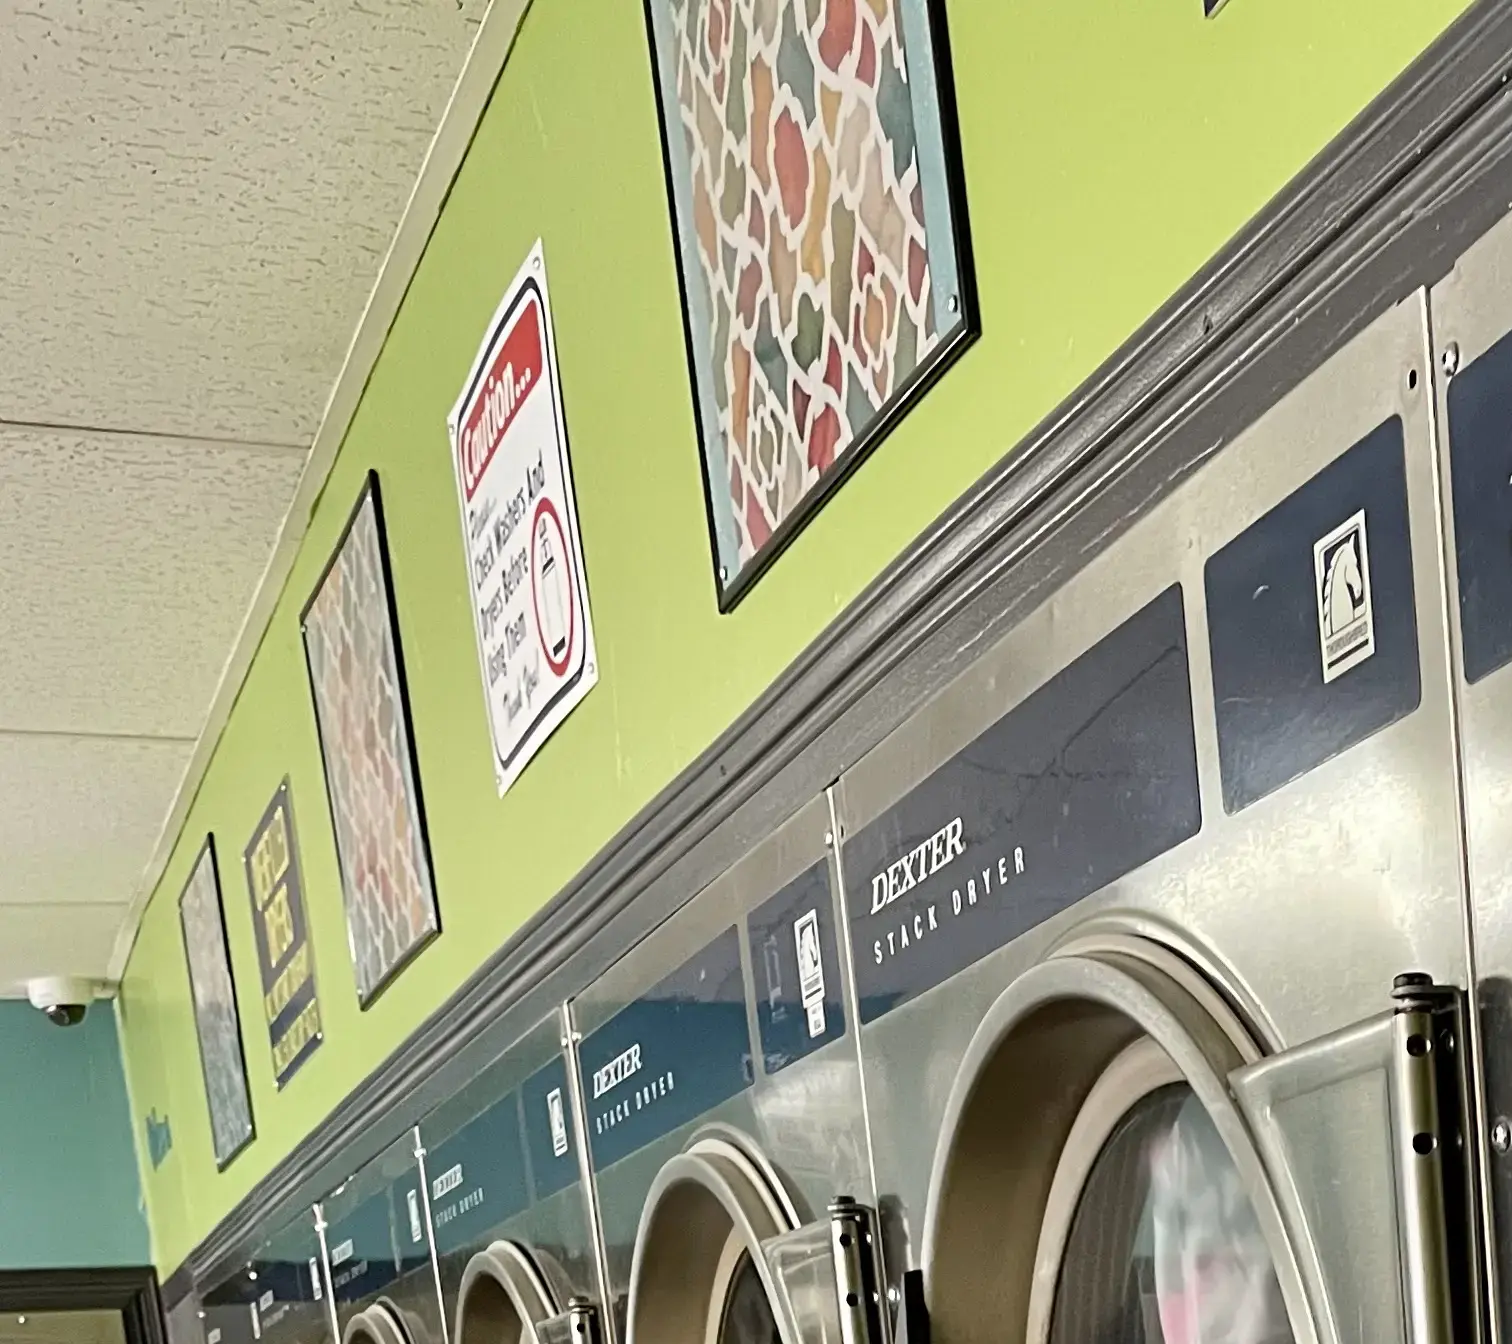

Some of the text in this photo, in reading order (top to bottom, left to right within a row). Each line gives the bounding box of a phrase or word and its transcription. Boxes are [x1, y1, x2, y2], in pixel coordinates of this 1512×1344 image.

[463, 361, 531, 490] Caution...
[870, 816, 966, 915] DEXTER
[874, 846, 1026, 965] STACK DRYER
[593, 1043, 642, 1099] DEXTER
